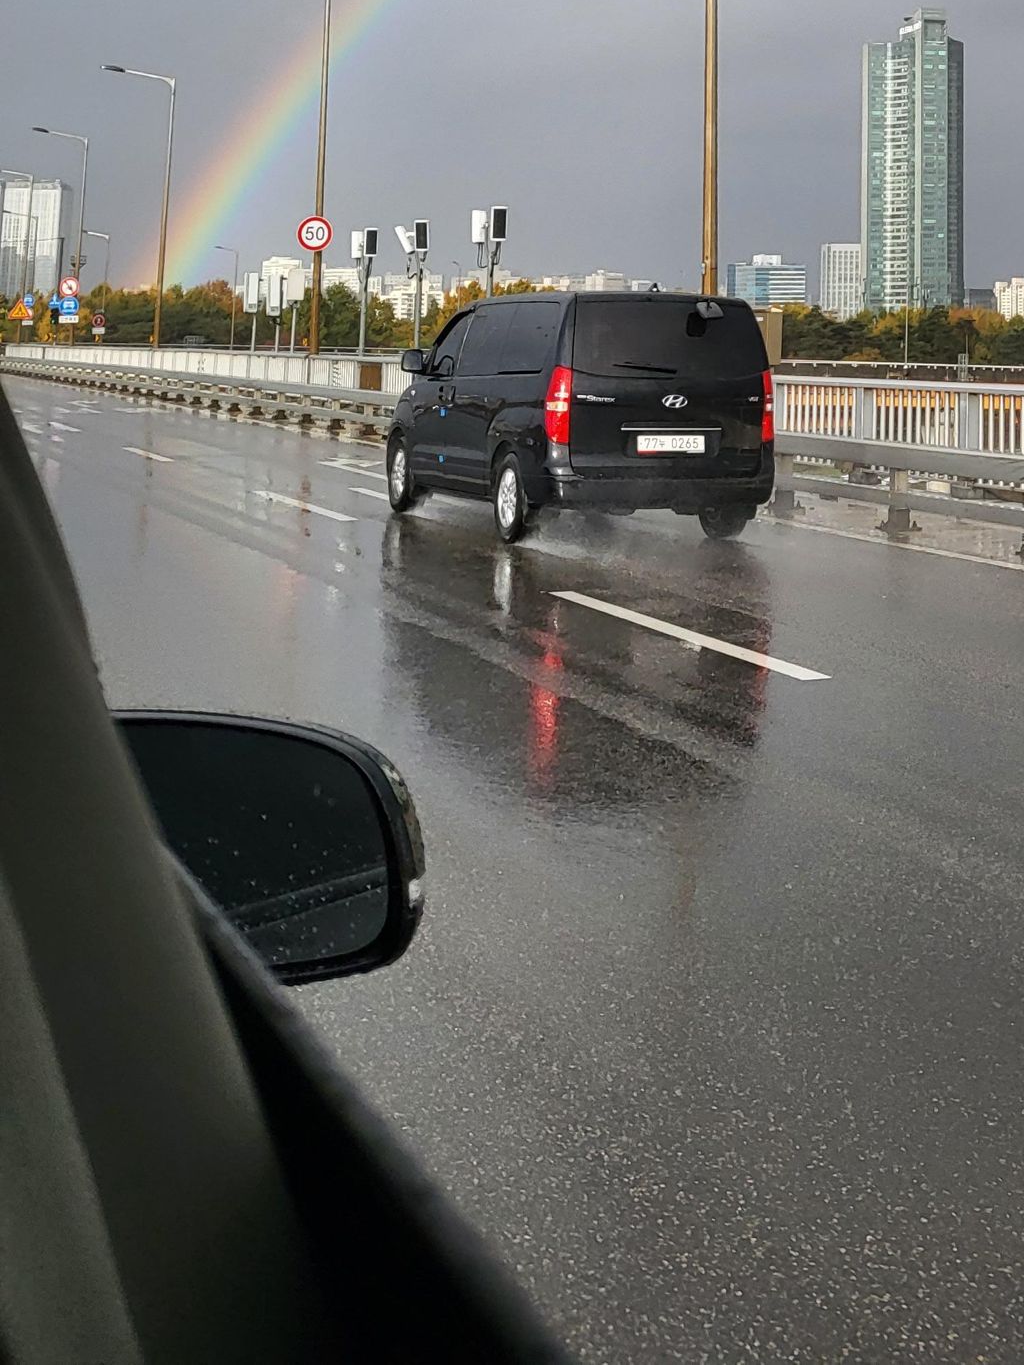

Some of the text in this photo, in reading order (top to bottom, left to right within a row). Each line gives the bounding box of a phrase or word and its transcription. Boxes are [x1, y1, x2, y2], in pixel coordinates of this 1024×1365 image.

[305, 226, 325, 241] 50
[586, 394, 616, 403] Starex
[671, 437, 699, 449] 0265
